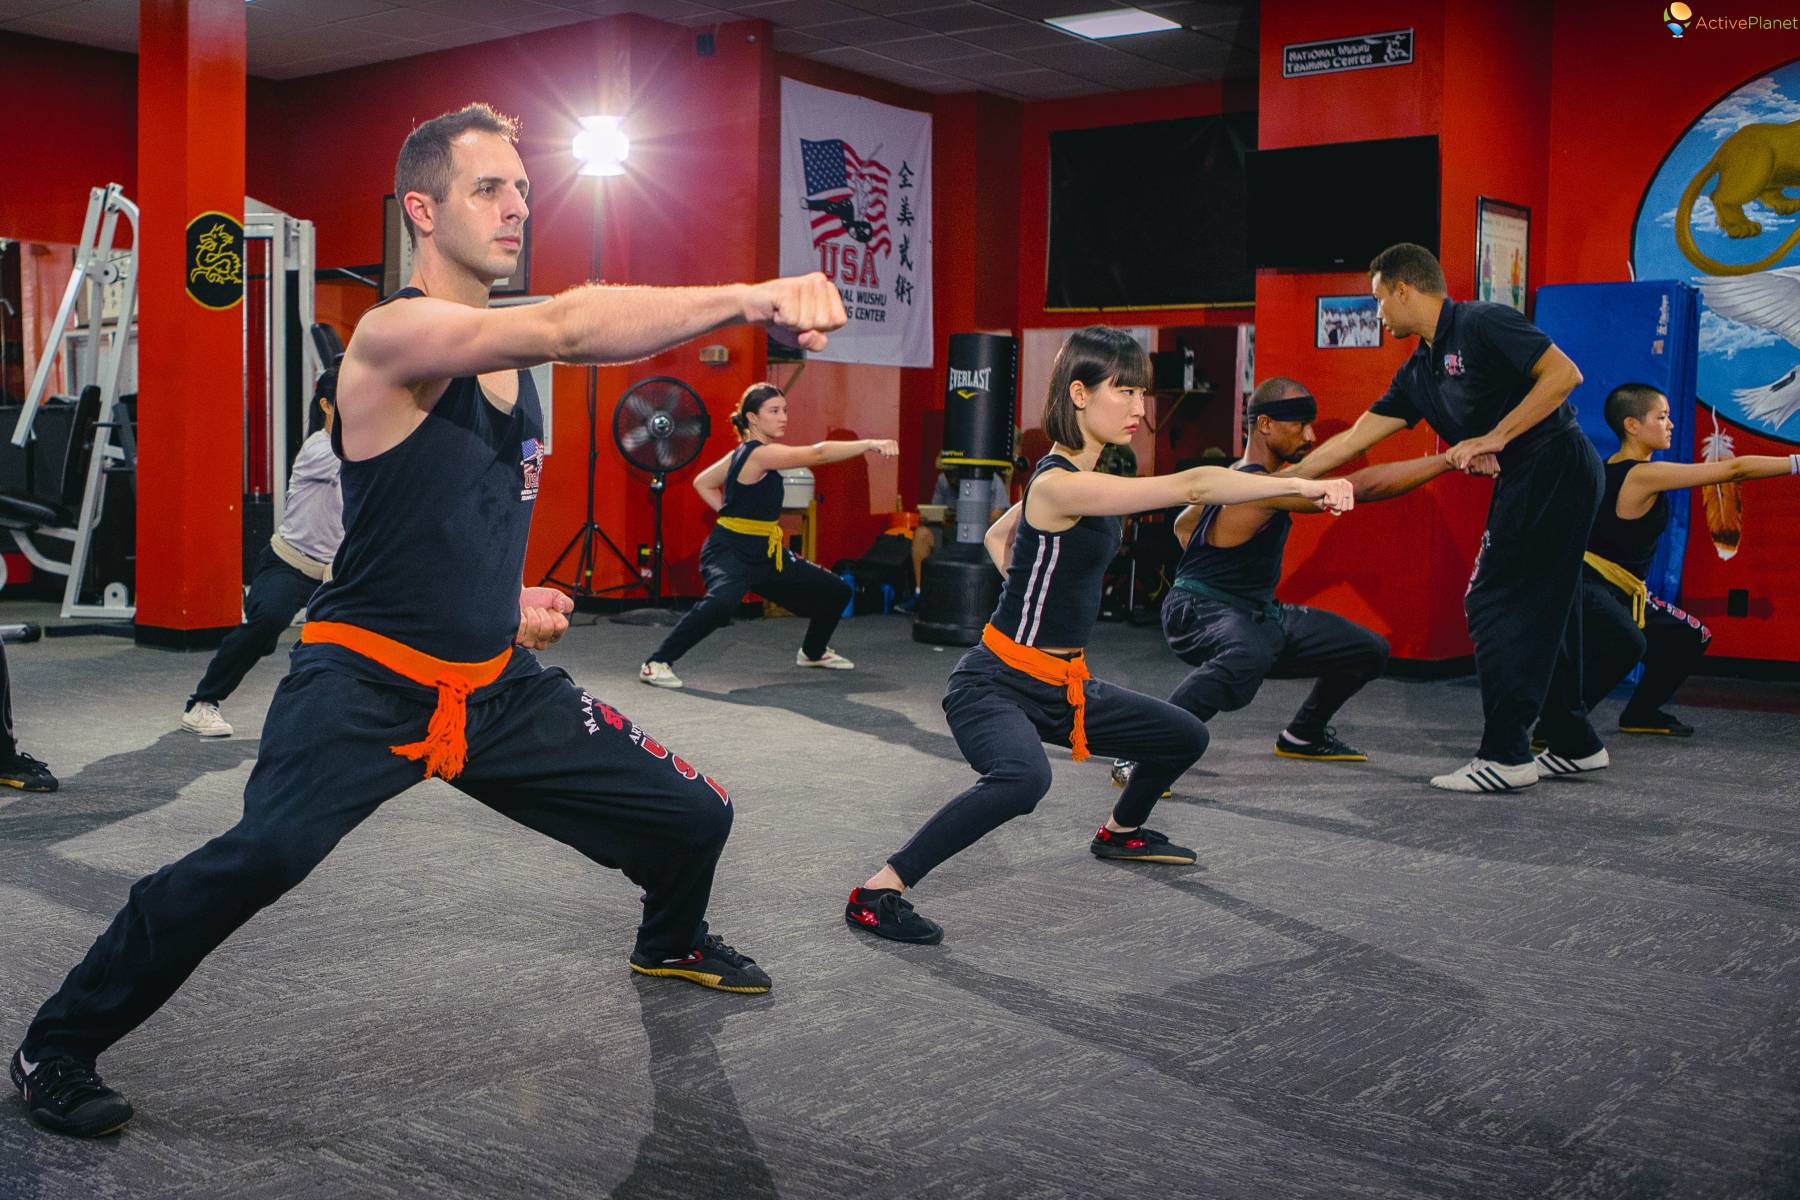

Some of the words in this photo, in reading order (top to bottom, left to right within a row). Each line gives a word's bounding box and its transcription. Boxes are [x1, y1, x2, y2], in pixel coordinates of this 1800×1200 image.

[1288, 47, 1336, 62] NATIONAL
[1286, 59, 1331, 73] TRAINING
[1332, 54, 1373, 67] CENTER
[820, 241, 879, 288] USA
[857, 290, 888, 306] WUSHU
[855, 307, 886, 322] CENTER
[948, 367, 991, 392] EVERLAST
